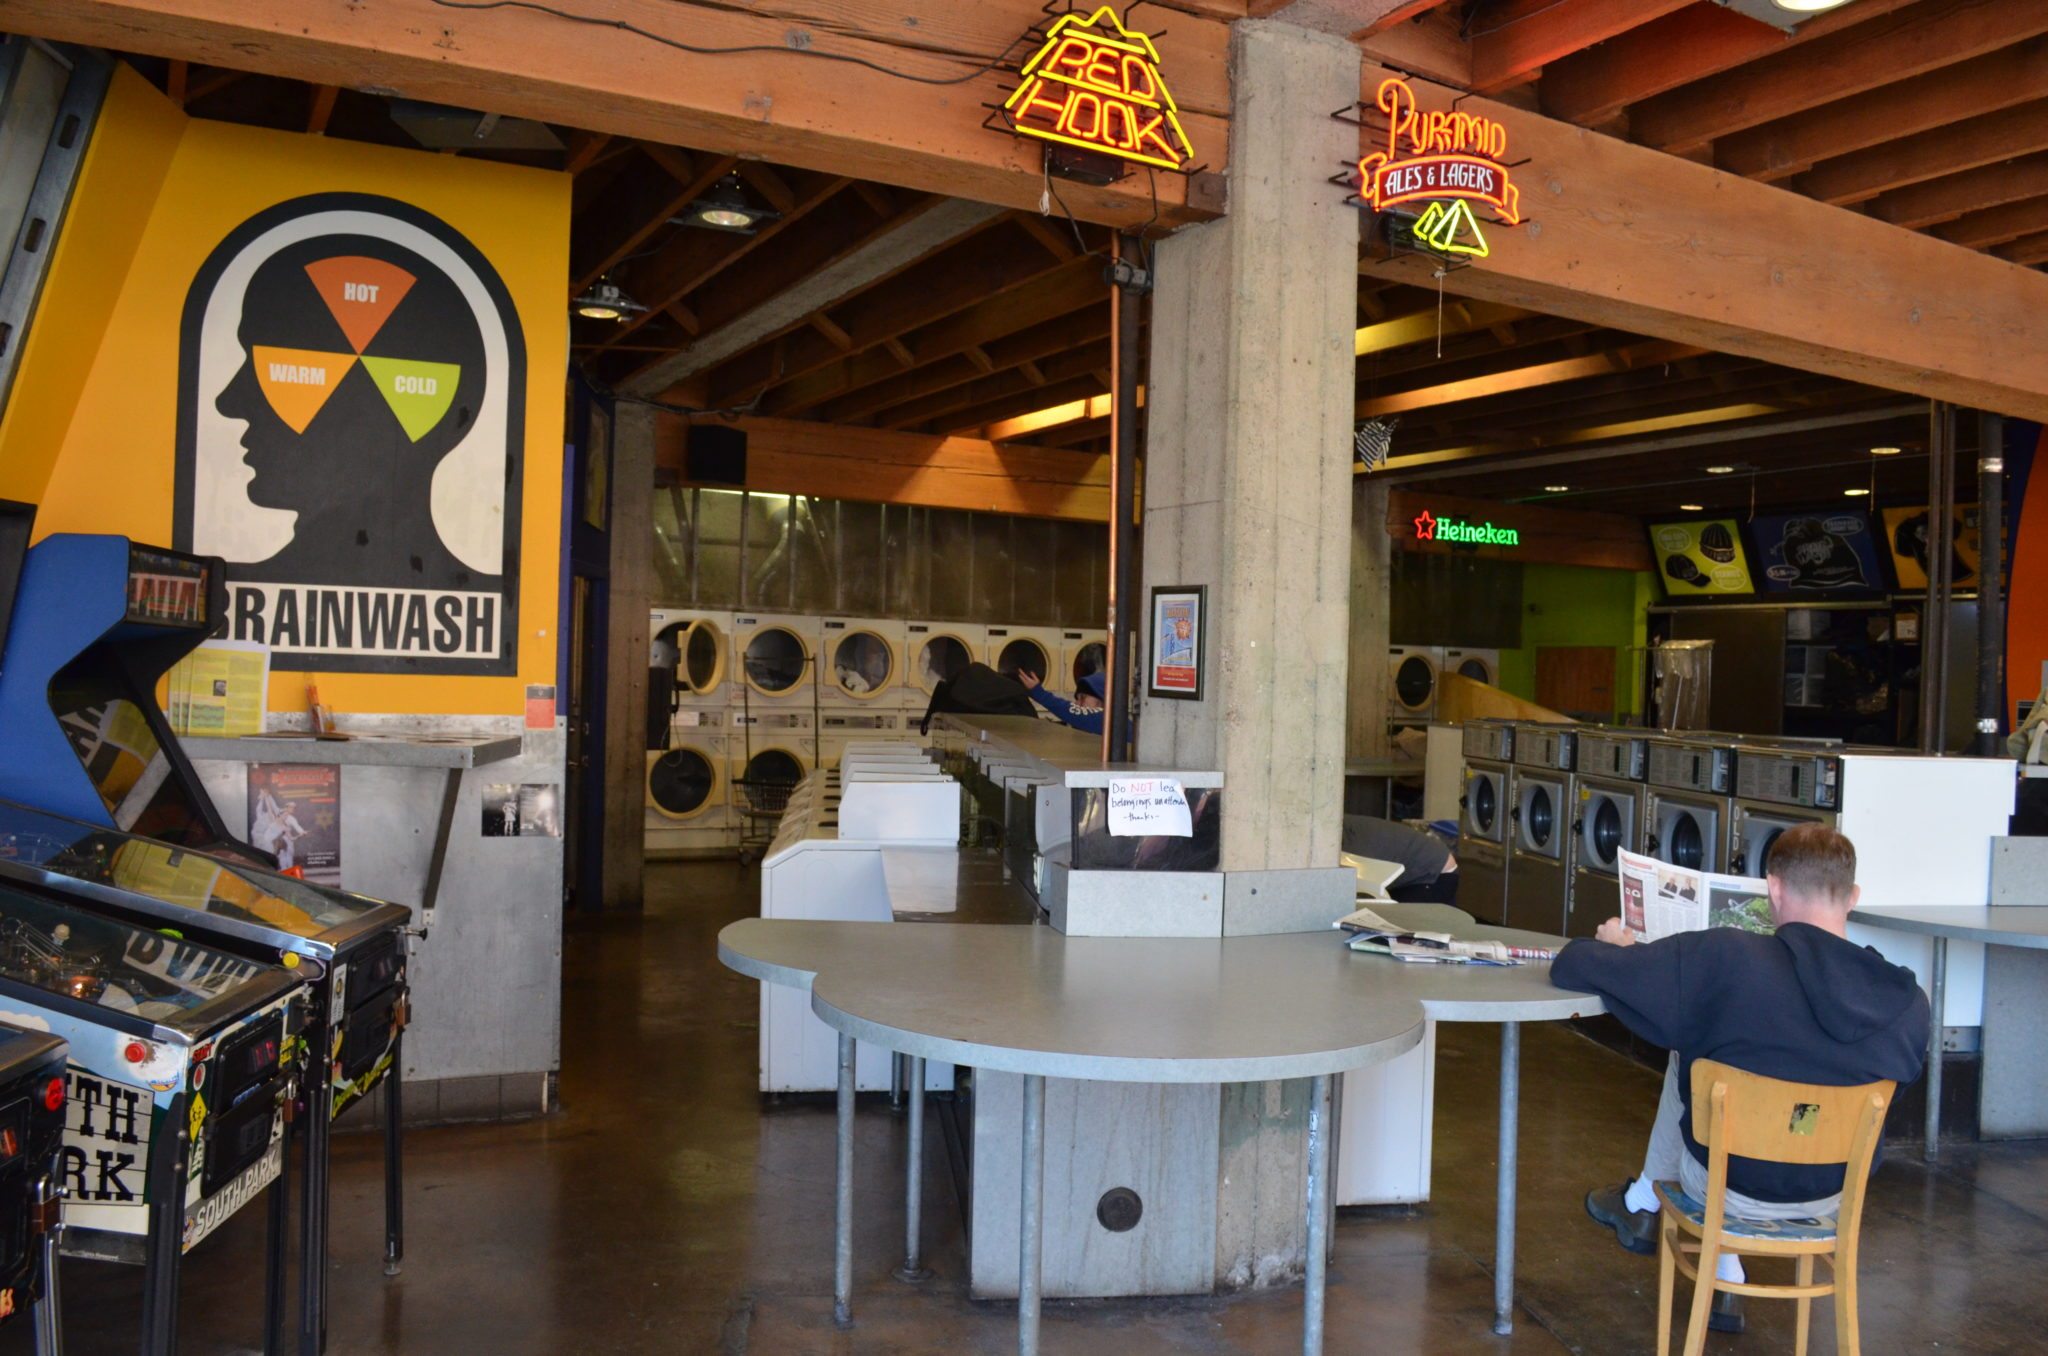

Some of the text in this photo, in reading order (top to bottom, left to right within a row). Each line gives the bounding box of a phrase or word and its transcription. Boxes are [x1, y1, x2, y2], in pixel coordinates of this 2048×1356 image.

[1045, 37, 1156, 101] RED
[1015, 79, 1180, 163] HOOK
[1384, 162, 1494, 196] ALES & LAGERS
[344, 282, 379, 304] HOT
[269, 362, 326, 387] WARM
[394, 375, 437, 397] COLD
[1435, 517, 1519, 546] Heineken
[212, 585, 494, 654] RAINWASH
[1112, 783, 1126, 794] Do
[1130, 782, 1153, 793] NOT
[66, 1074, 139, 1145] TH
[196, 1181, 243, 1239] SOUTH
[242, 1150, 278, 1201] PARK
